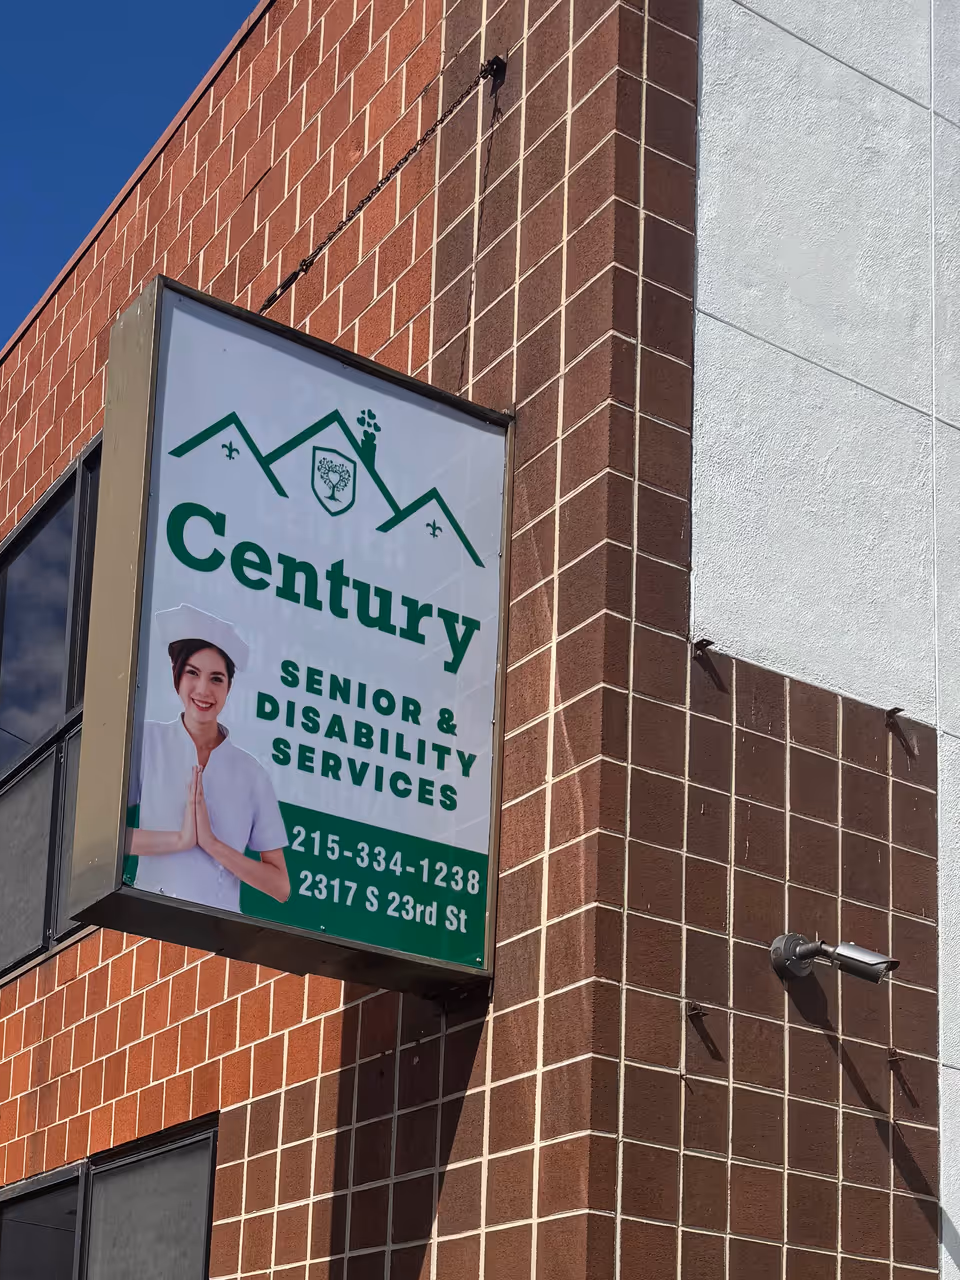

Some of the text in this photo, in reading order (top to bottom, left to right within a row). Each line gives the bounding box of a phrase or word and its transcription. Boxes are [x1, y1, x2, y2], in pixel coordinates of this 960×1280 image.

[166, 501, 481, 675] Century
[255, 692, 477, 778] DISABILITY
[280, 659, 457, 736] SENIOR &
[271, 737, 457, 812] SERVICES
[291, 825, 480, 896] 215-334-1238
[298, 870, 468, 934] 2317 S 23rd St
